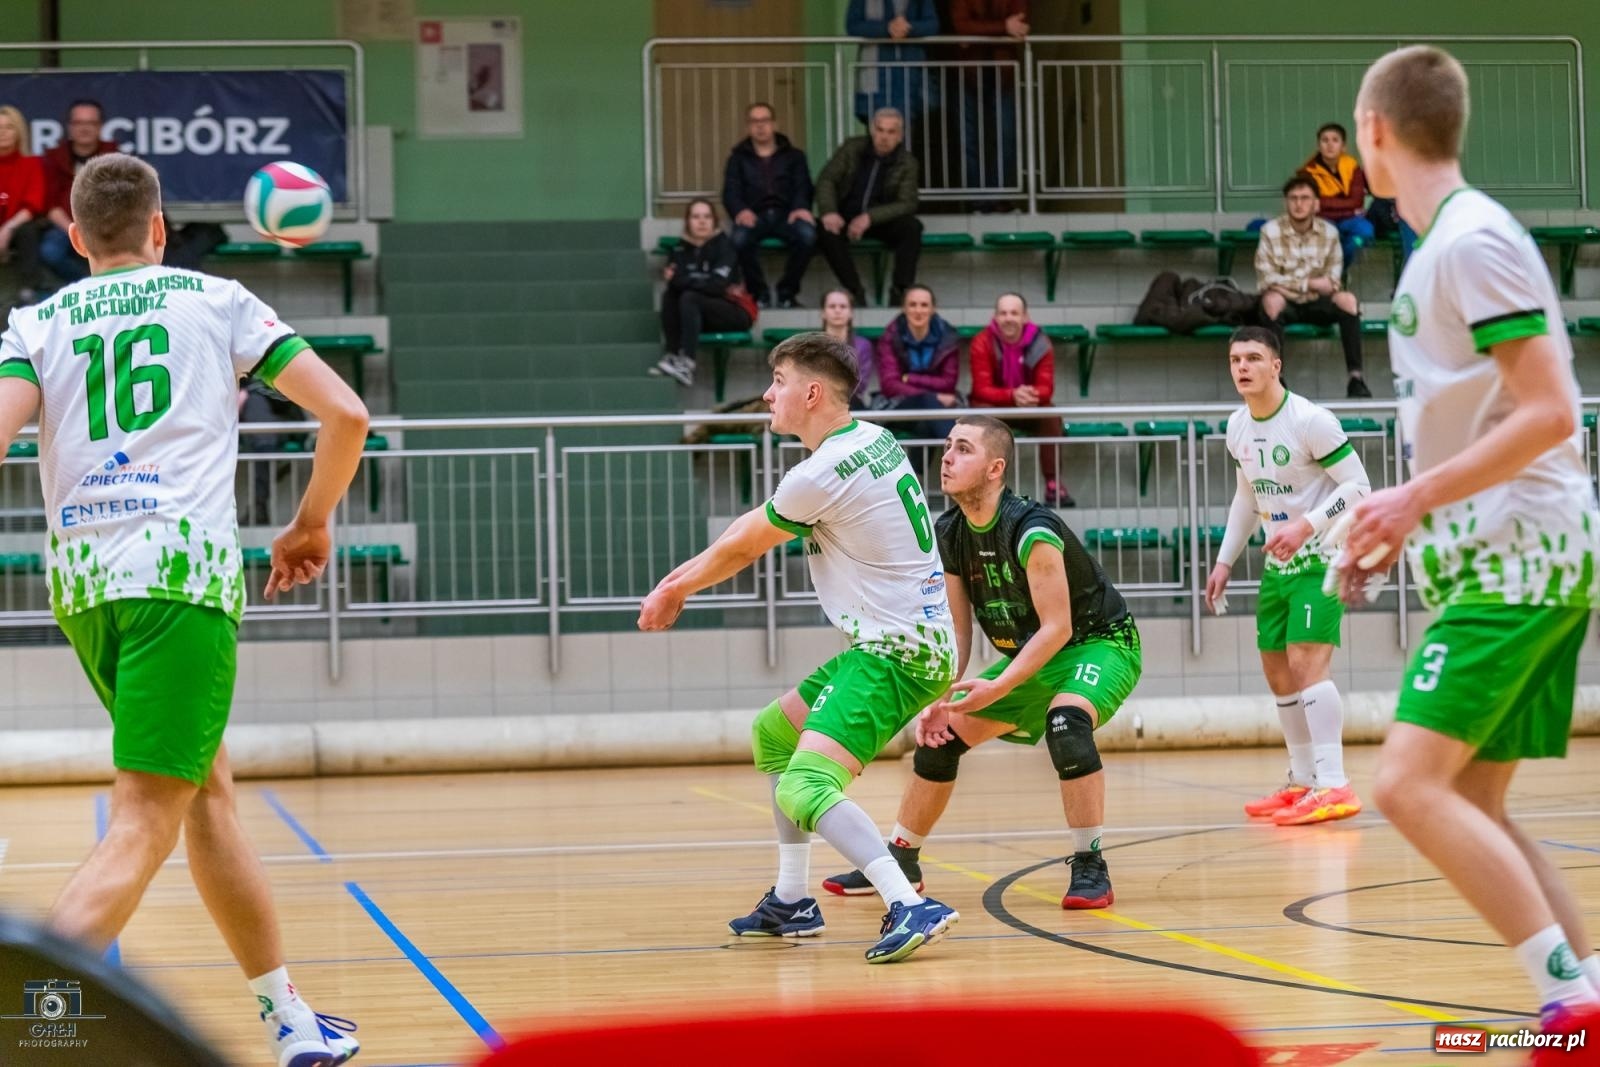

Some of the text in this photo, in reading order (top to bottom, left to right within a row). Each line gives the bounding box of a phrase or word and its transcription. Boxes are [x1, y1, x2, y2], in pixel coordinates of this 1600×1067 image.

[31, 105, 291, 155] RCIBÓRZ
[73, 323, 172, 441] 16
[834, 449, 870, 480] KLUB
[1258, 448, 1265, 468] 1
[78, 473, 160, 487] ZPIECZENIA
[61, 497, 158, 527] ENTECO
[897, 473, 934, 553] 6
[983, 563, 1001, 588] 15
[1304, 604, 1312, 629] 1
[1074, 663, 1102, 687] 15
[1413, 642, 1448, 692] 3
[811, 685, 834, 712] 6
